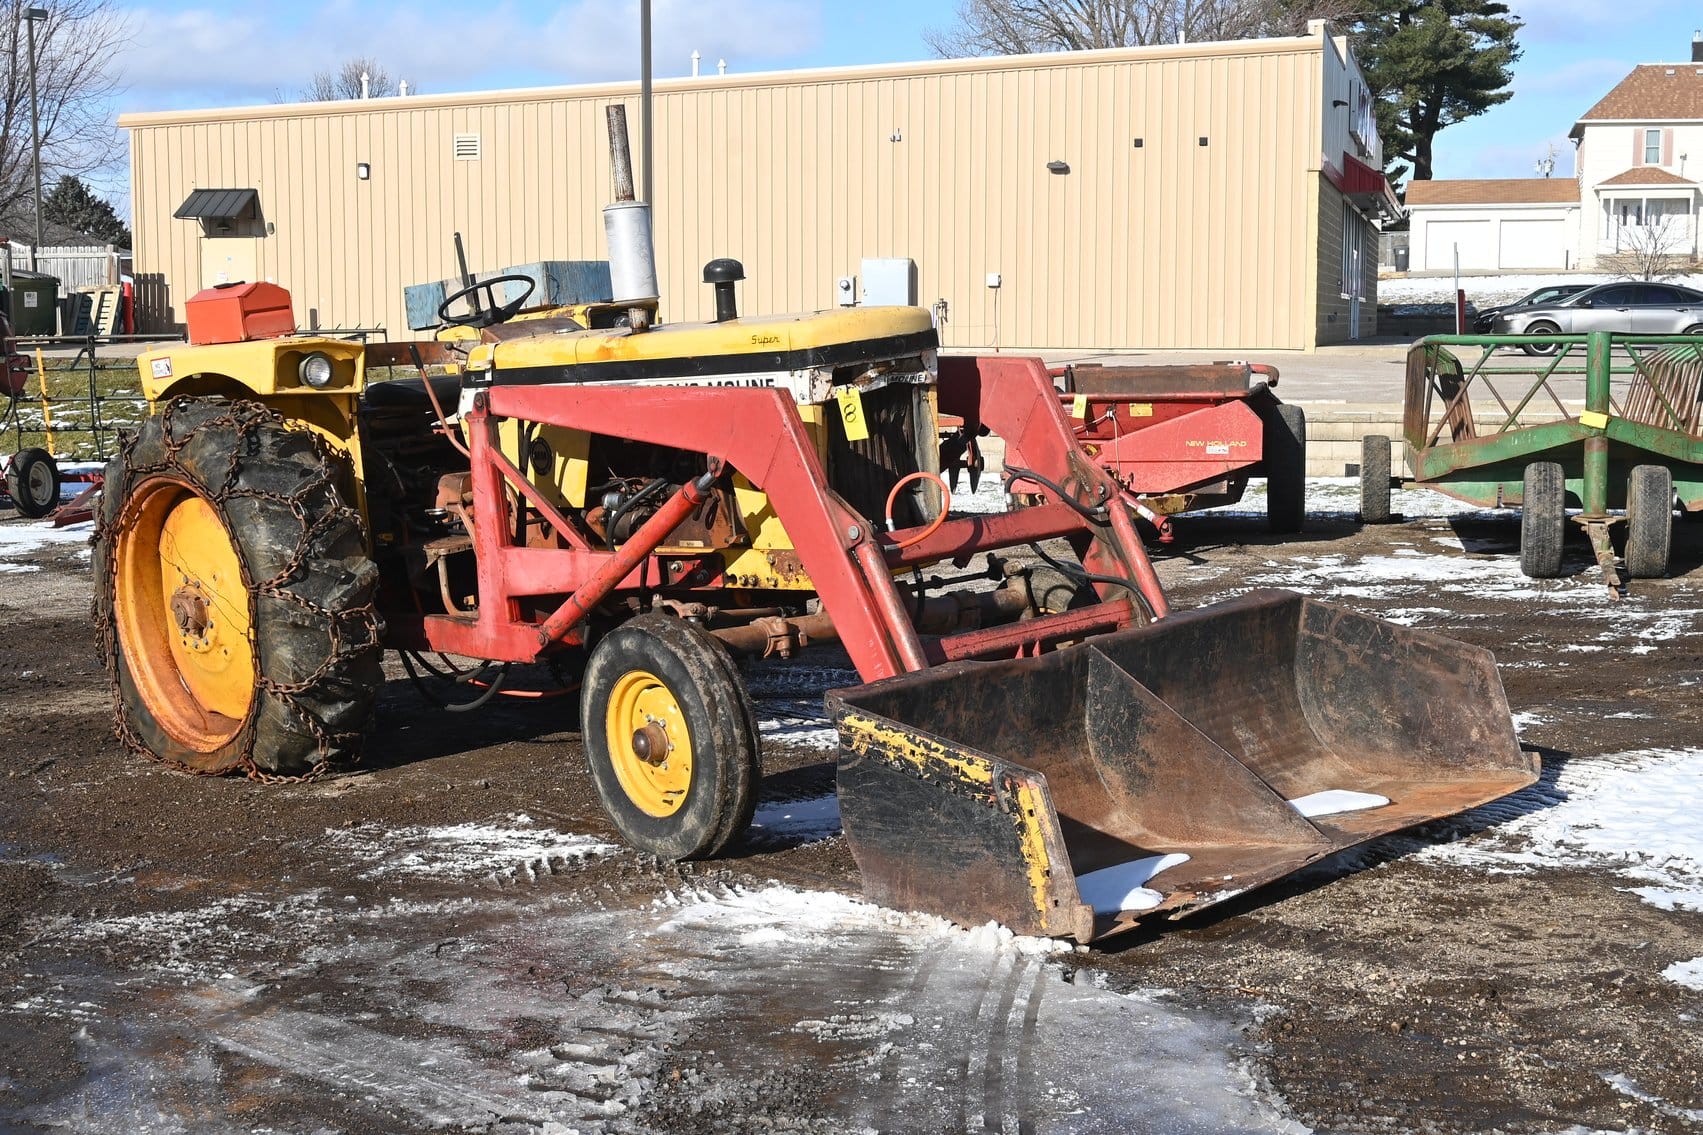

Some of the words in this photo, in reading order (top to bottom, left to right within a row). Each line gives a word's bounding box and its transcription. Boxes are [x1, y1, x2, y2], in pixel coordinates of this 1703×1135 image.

[751, 334, 780, 348] Super
[890, 374, 923, 383] MOLINE
[843, 403, 857, 423] 8
